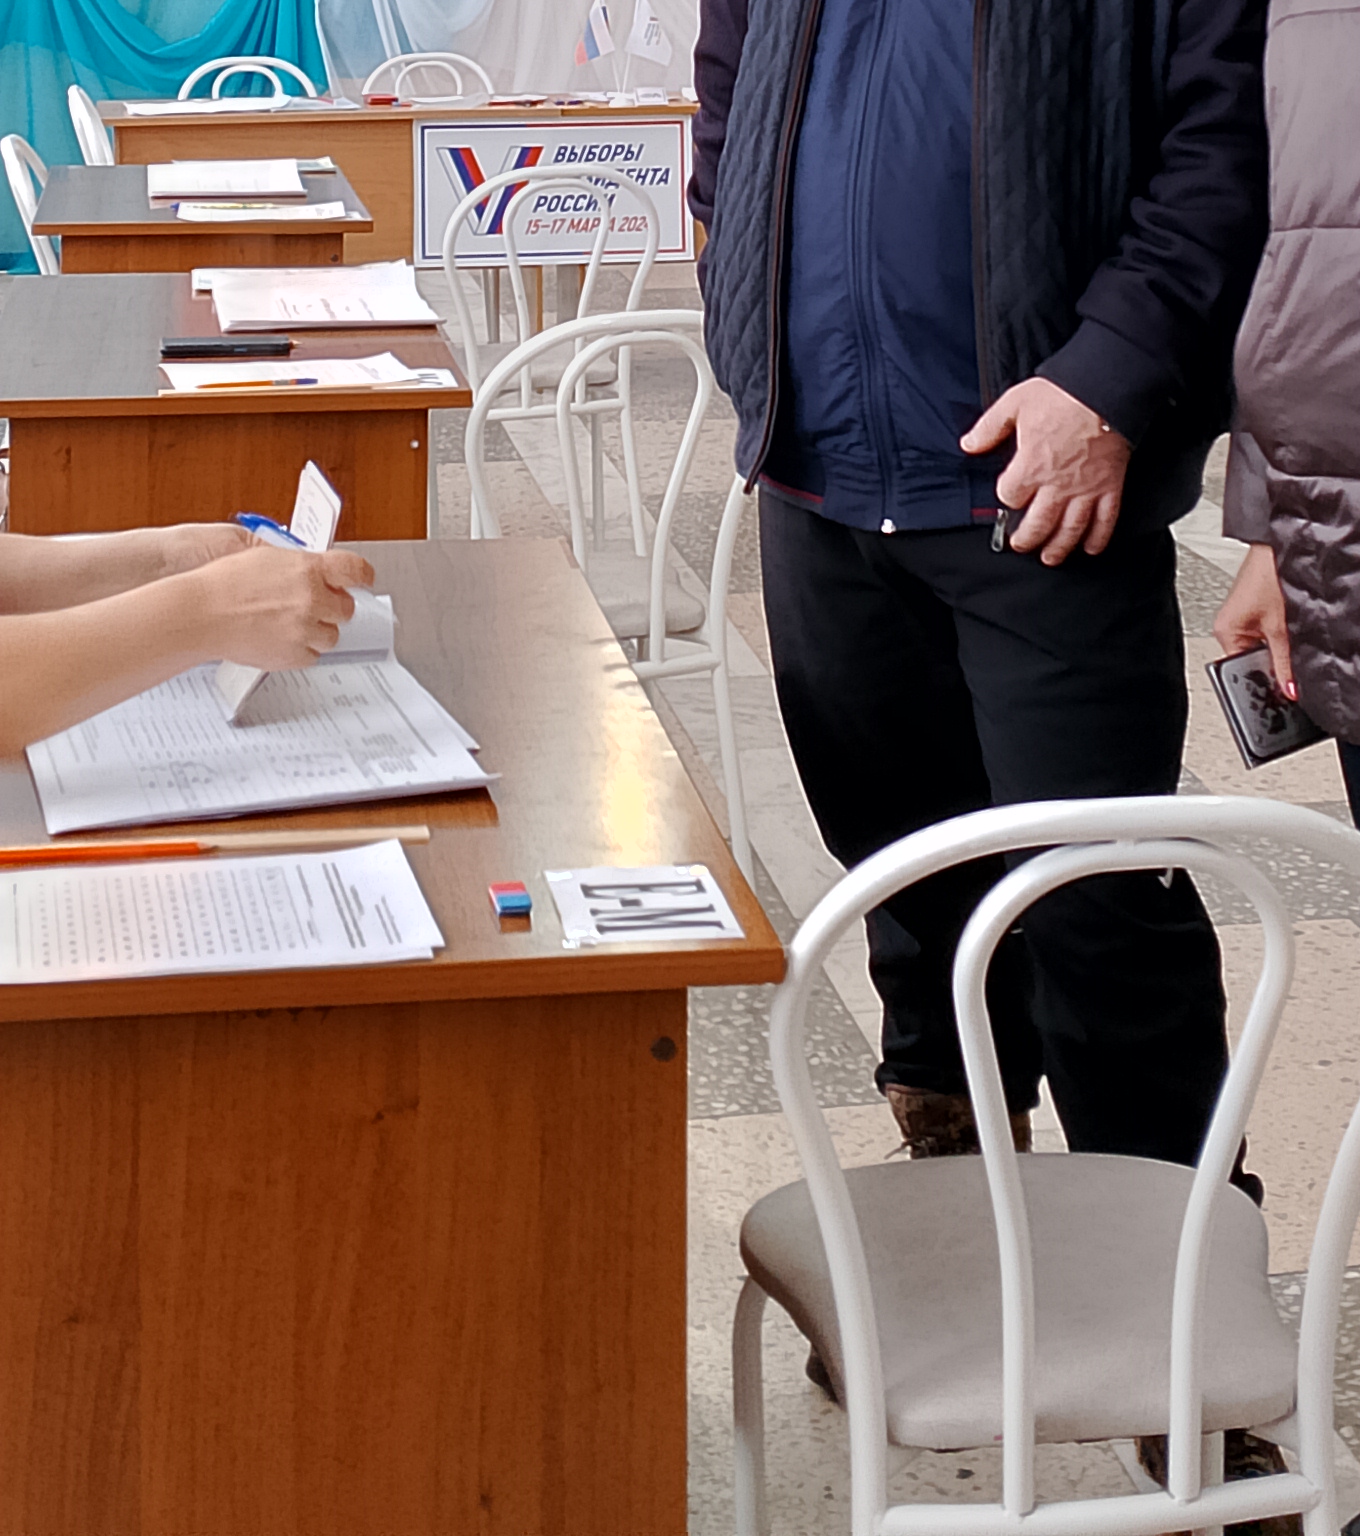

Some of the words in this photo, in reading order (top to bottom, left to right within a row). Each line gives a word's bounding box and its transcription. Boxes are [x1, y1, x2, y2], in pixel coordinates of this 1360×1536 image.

[552, 143, 645, 164] ВЫБОРЫ
[565, 215, 616, 234] МАРА
[617, 215, 649, 233] 202
